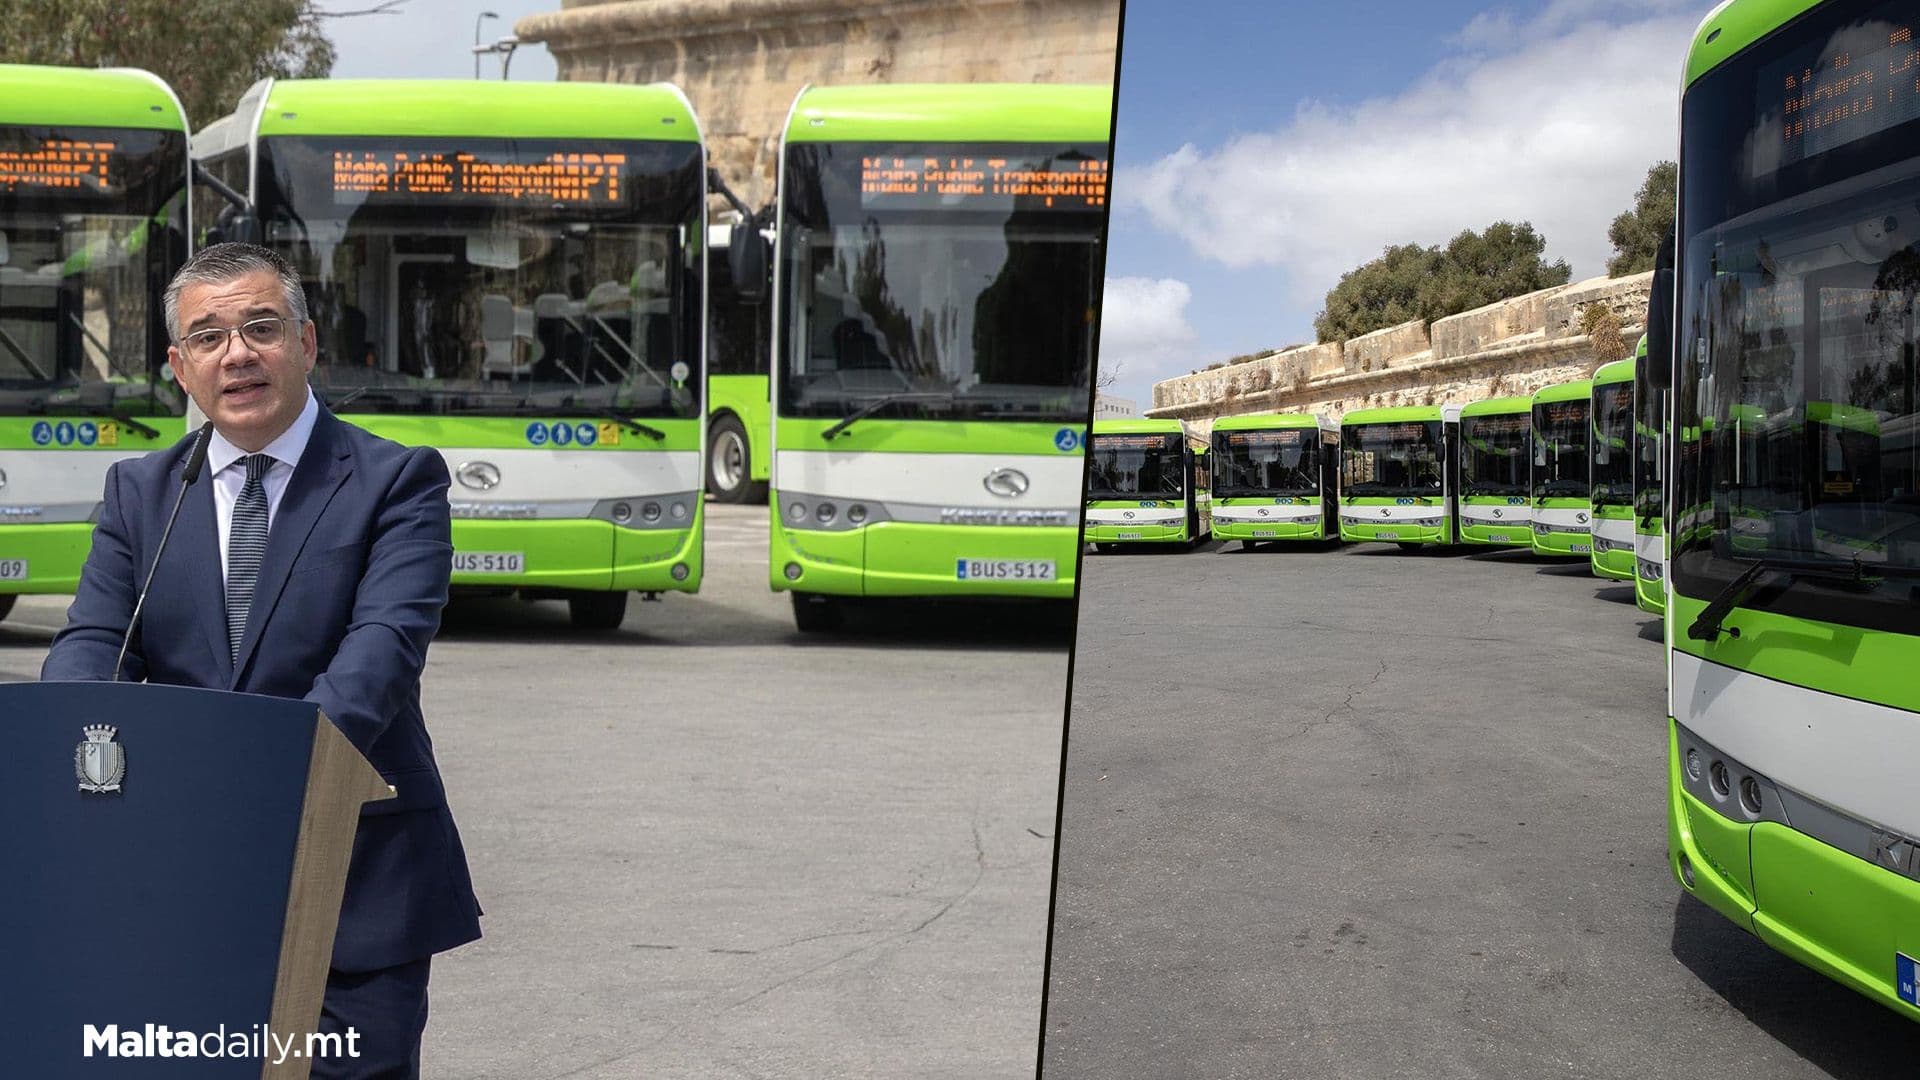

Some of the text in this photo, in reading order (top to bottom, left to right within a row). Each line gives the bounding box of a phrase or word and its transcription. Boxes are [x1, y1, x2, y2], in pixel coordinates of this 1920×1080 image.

[334, 152, 388, 192] Malta
[394, 153, 453, 192] Public
[862, 158, 917, 193] Malta
[924, 158, 984, 193] Public
